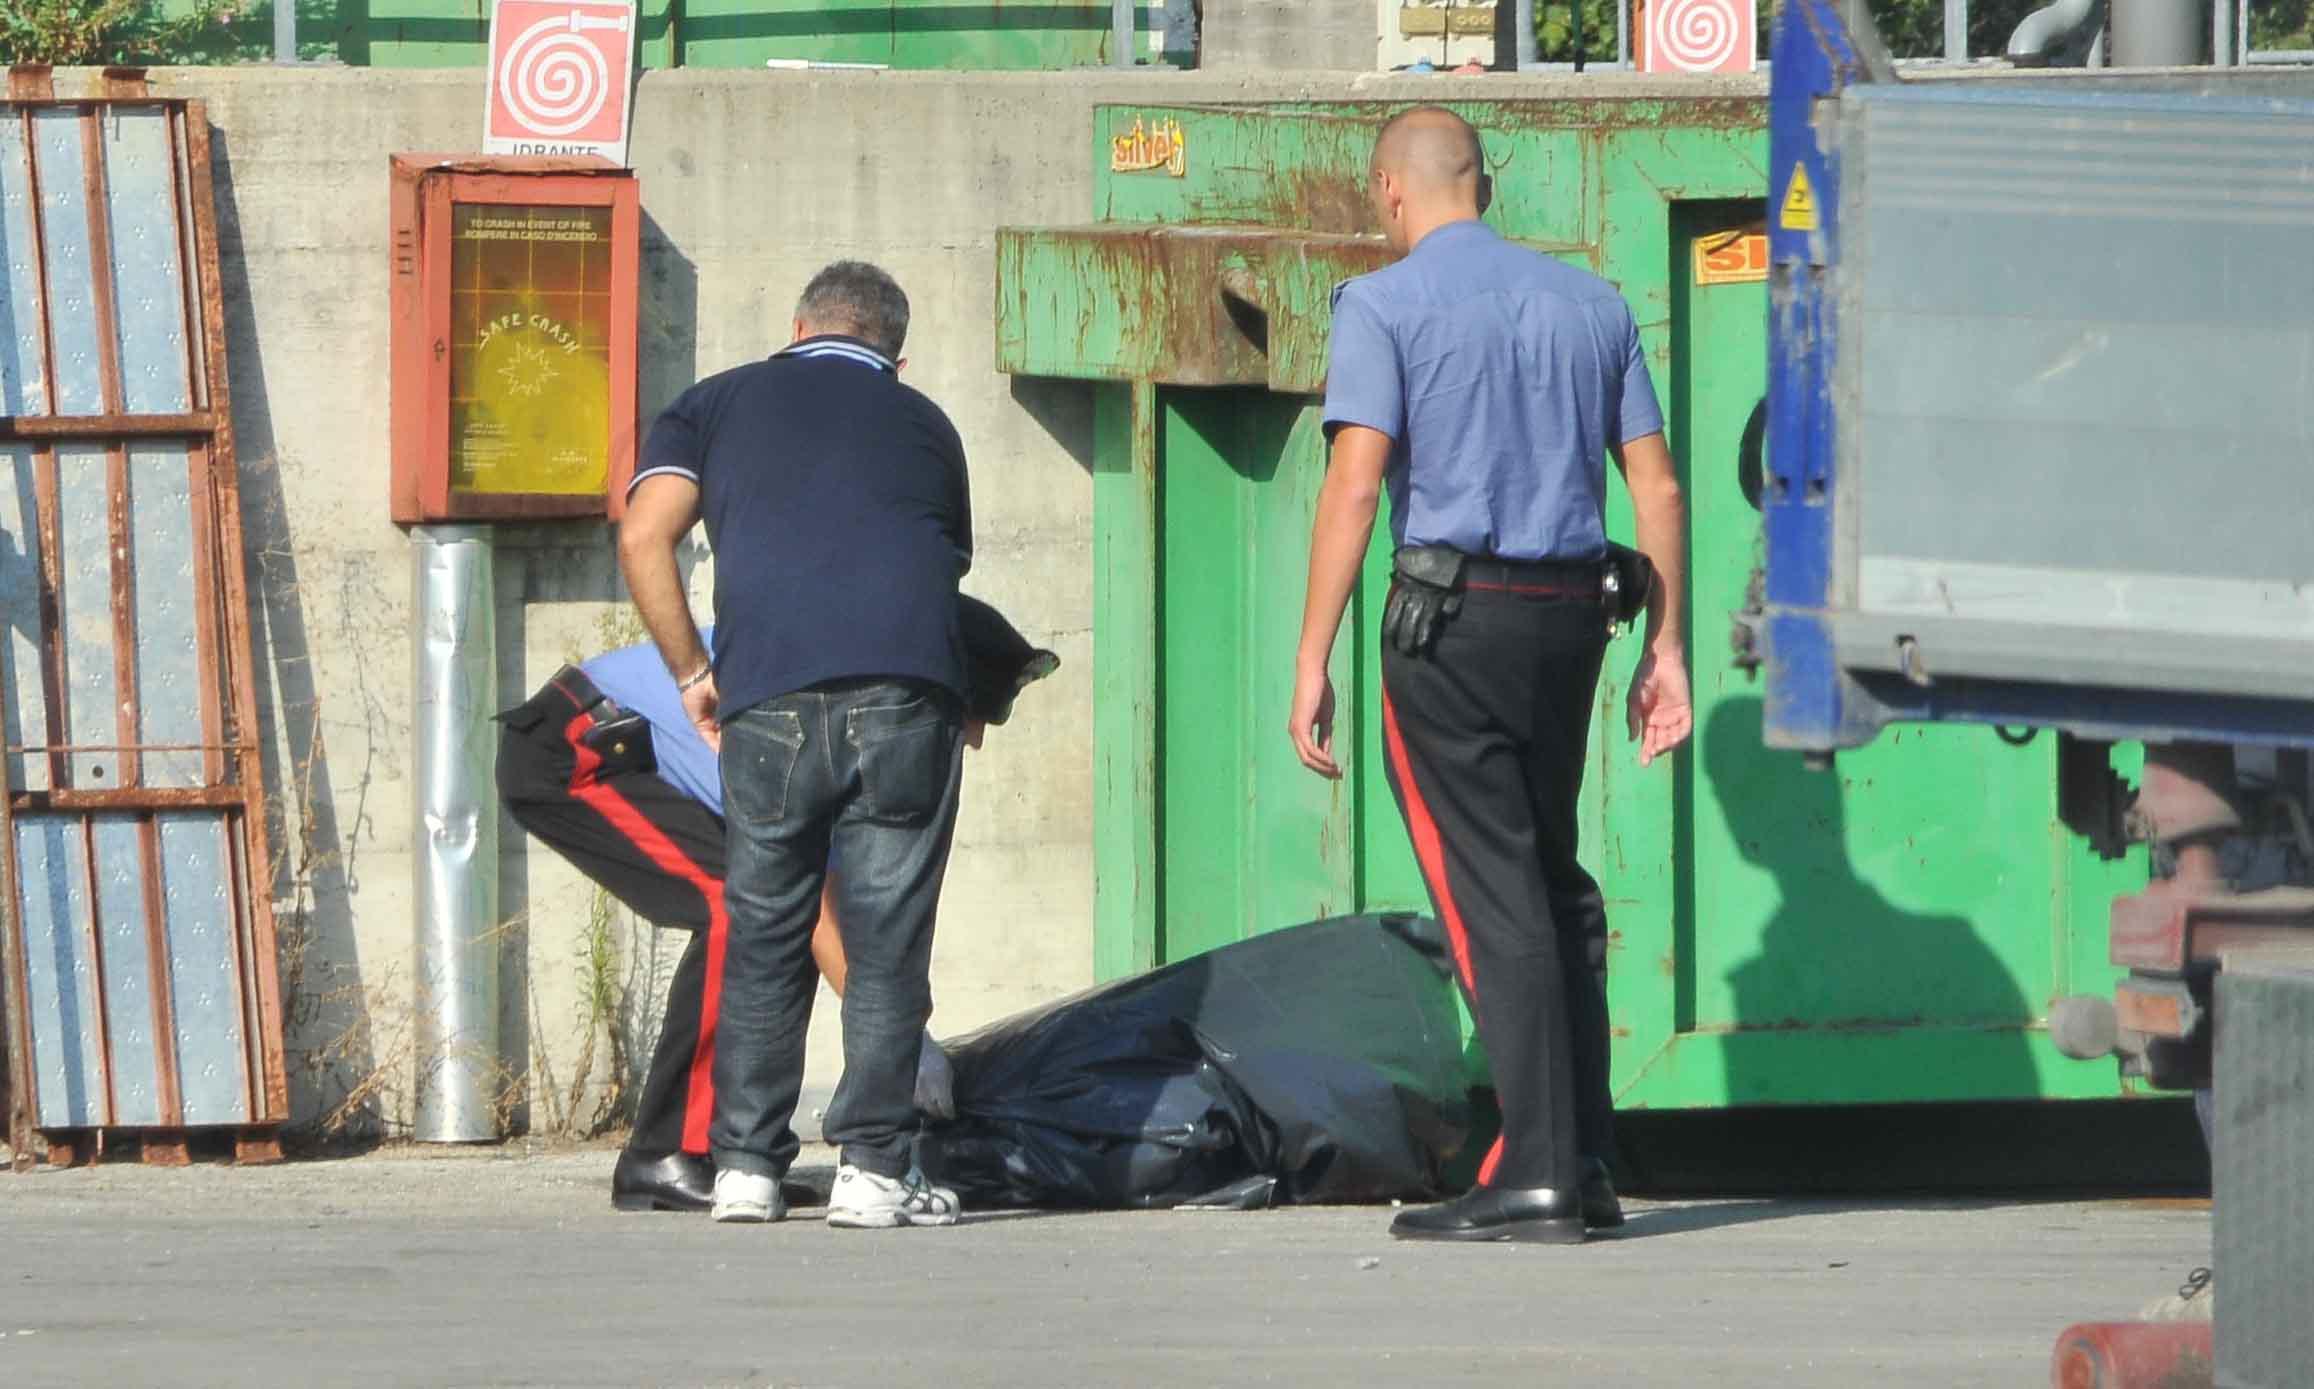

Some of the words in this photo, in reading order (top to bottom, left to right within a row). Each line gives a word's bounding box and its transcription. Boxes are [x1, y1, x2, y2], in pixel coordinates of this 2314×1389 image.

[471, 219, 482, 230] TO
[484, 219, 515, 230] CRASH
[516, 219, 527, 230] IN
[528, 219, 556, 230] EVENT
[557, 219, 569, 230] OF
[571, 220, 592, 230] FIRE
[509, 230, 520, 240] IN
[521, 230, 546, 241] CASO
[480, 313, 522, 351] SAFE
[529, 314, 581, 354] CRASH
